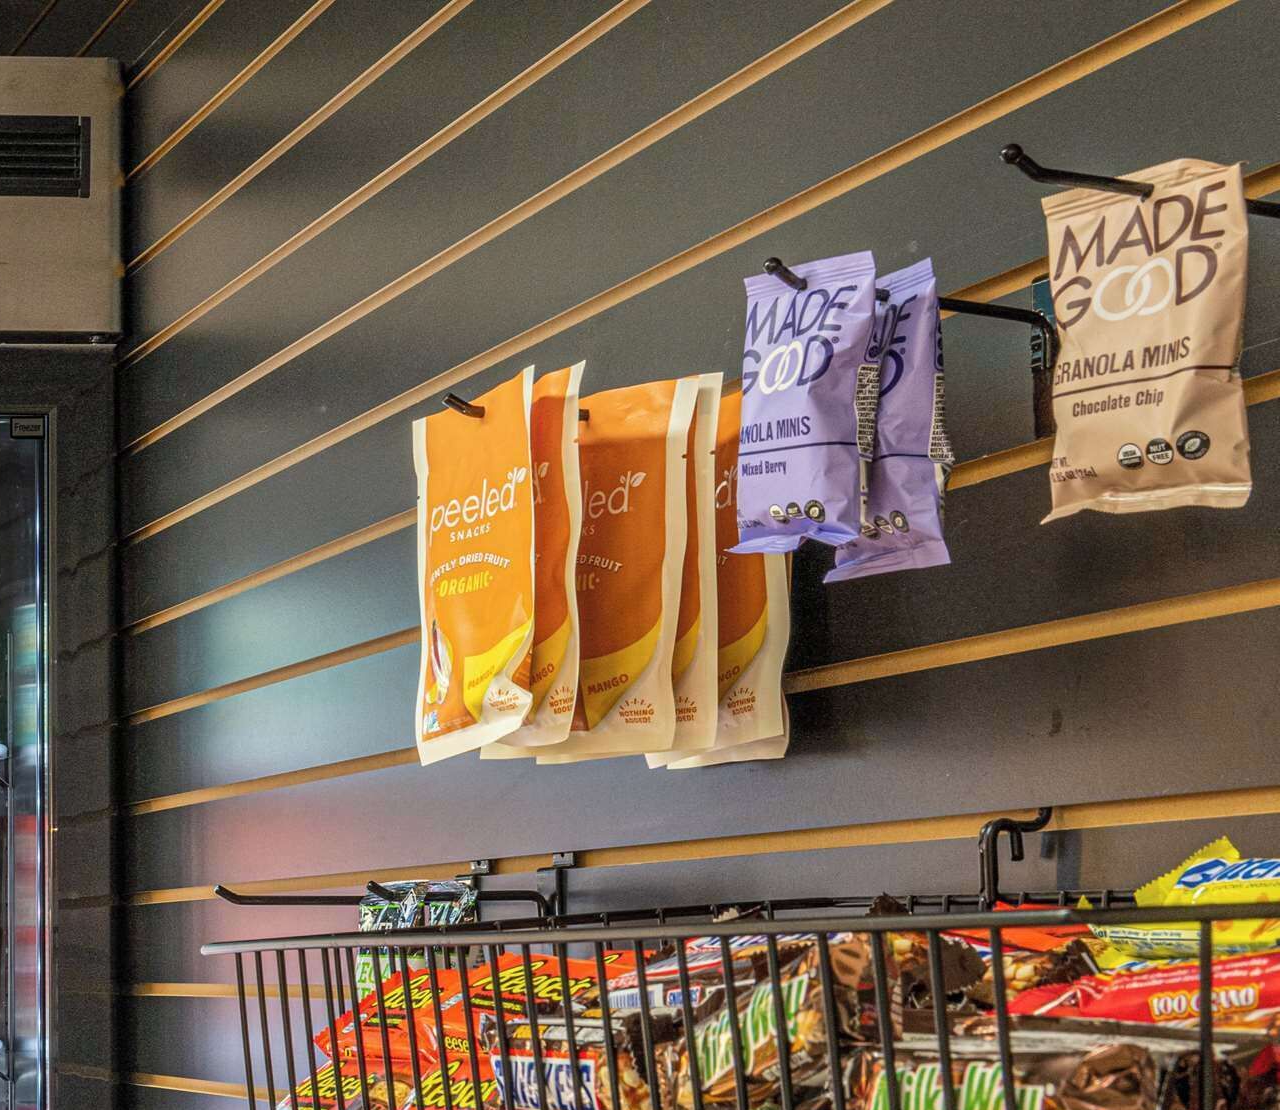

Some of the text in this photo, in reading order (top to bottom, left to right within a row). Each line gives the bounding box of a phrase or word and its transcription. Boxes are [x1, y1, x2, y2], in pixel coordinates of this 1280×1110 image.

[1054, 180, 1227, 281] MADE
[1053, 244, 1218, 331] GOOD
[745, 284, 858, 345] MADE
[742, 334, 835, 395] GOOD
[1055, 336, 1191, 386] GRANOLA MINIS
[1072, 389, 1164, 418] Chocolate Chip
[1149, 443, 1167, 453] NUT
[1152, 452, 1170, 462] FREE
[741, 460, 788, 477] Mixed Berry
[449, 523, 491, 543] SNACKS
[458, 552, 511, 571] DRIED FRUIT
[586, 673, 629, 696] MANGO
[618, 707, 655, 719] NOTHING
[1151, 994, 1189, 1017] 100
